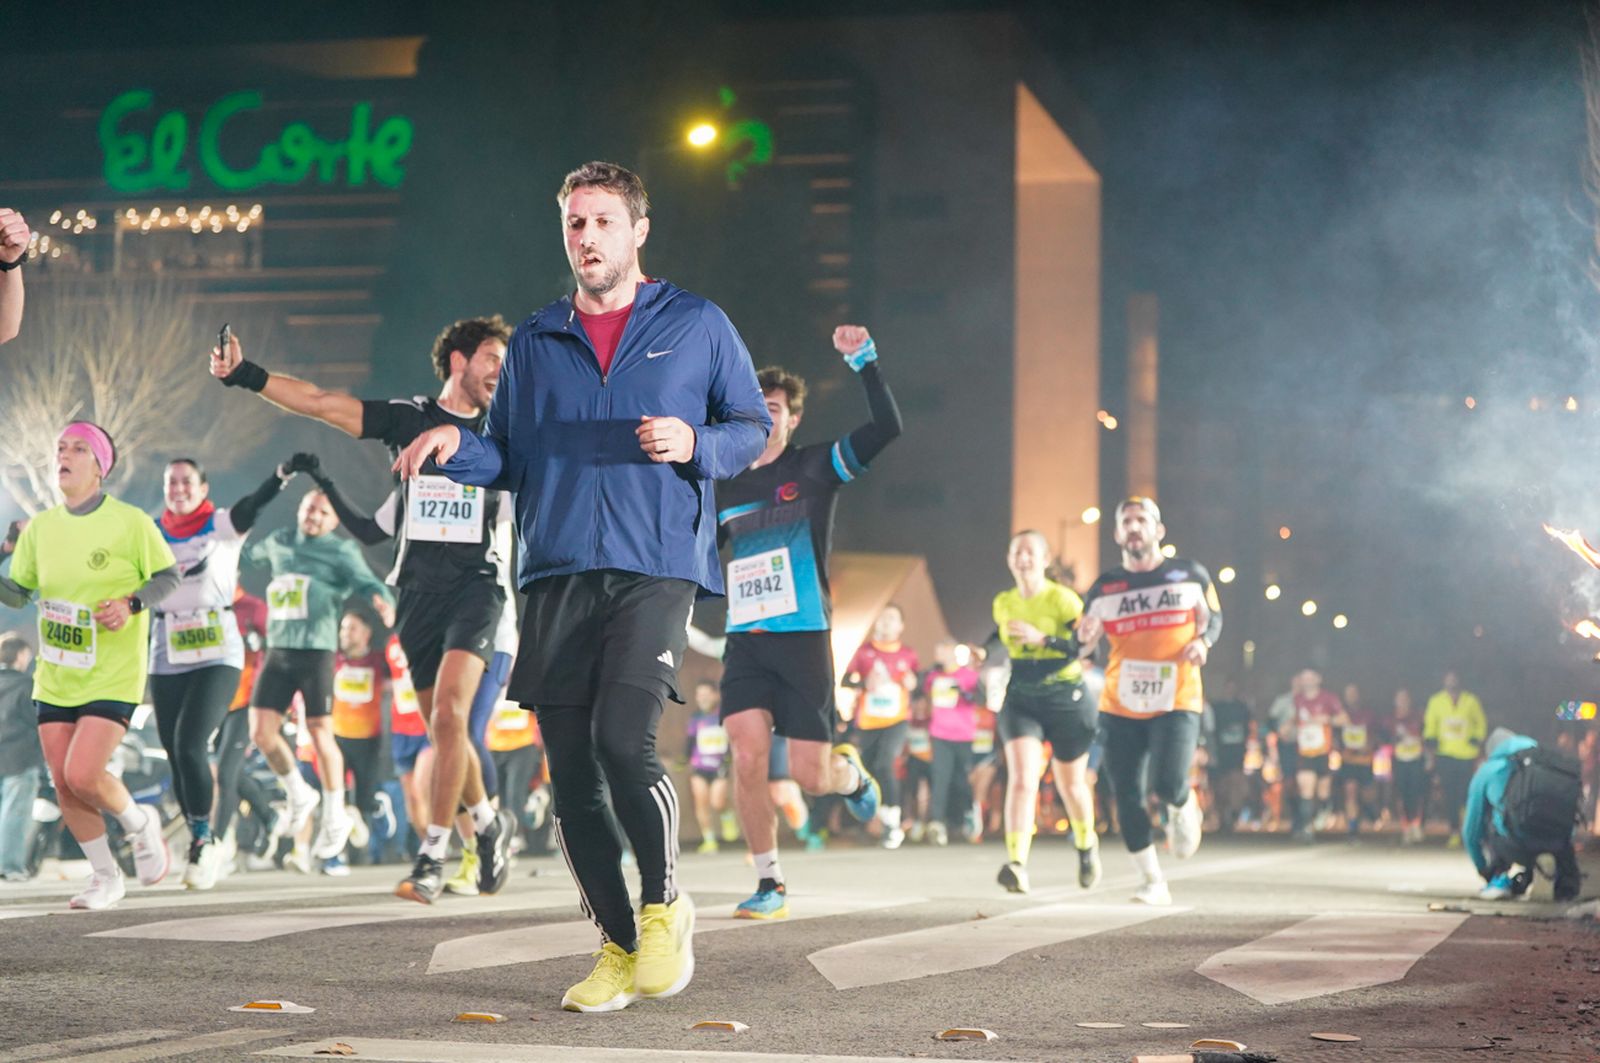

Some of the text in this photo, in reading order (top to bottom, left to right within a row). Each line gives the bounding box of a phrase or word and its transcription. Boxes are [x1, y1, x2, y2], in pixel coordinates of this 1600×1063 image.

[98, 89, 413, 191] El Corte
[419, 500, 472, 520] 12740
[738, 574, 783, 599] 12842
[1118, 593, 1151, 615] Ark
[47, 621, 82, 646] 2466
[1132, 680, 1164, 695] 5217
